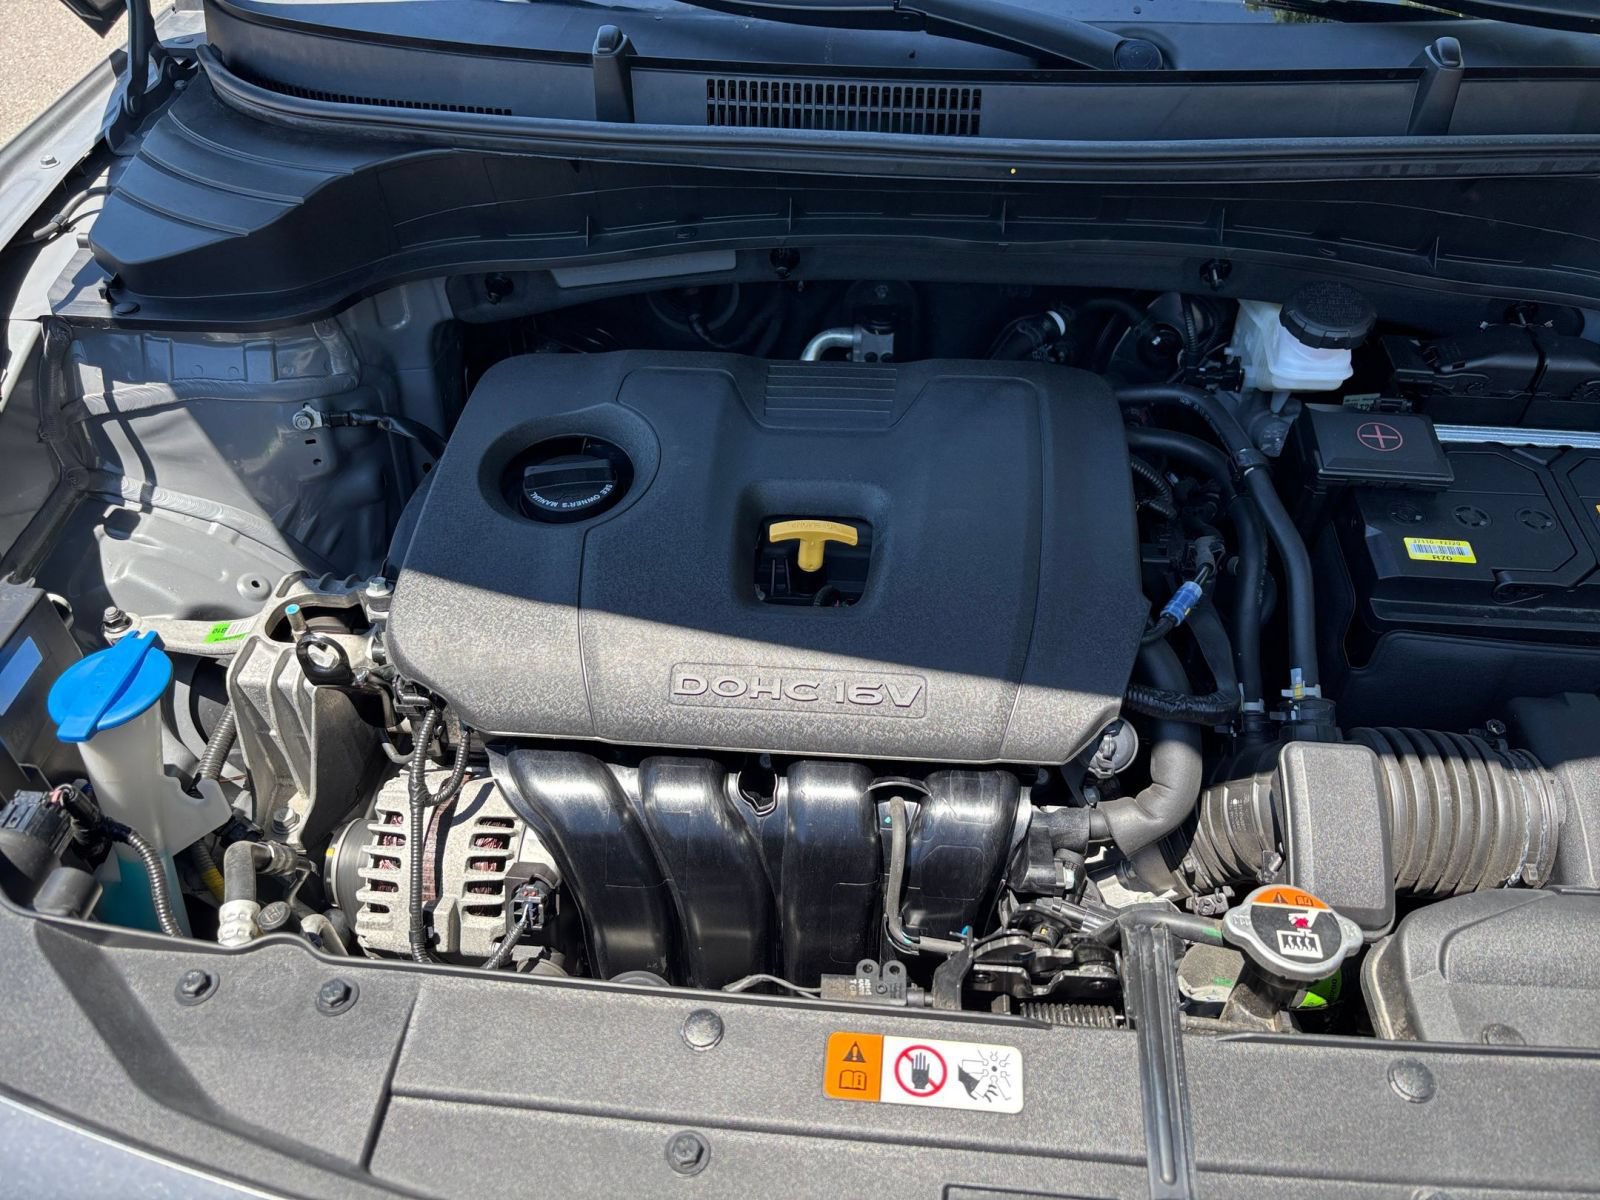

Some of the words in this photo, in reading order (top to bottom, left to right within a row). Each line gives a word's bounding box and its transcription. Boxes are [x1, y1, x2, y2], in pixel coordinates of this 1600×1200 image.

[600, 484, 613, 495] SEE
[530, 491, 559, 508] MANUAL
[561, 494, 601, 508] OWNER'S
[673, 677, 821, 702] DOHC
[834, 681, 922, 708] 16V
